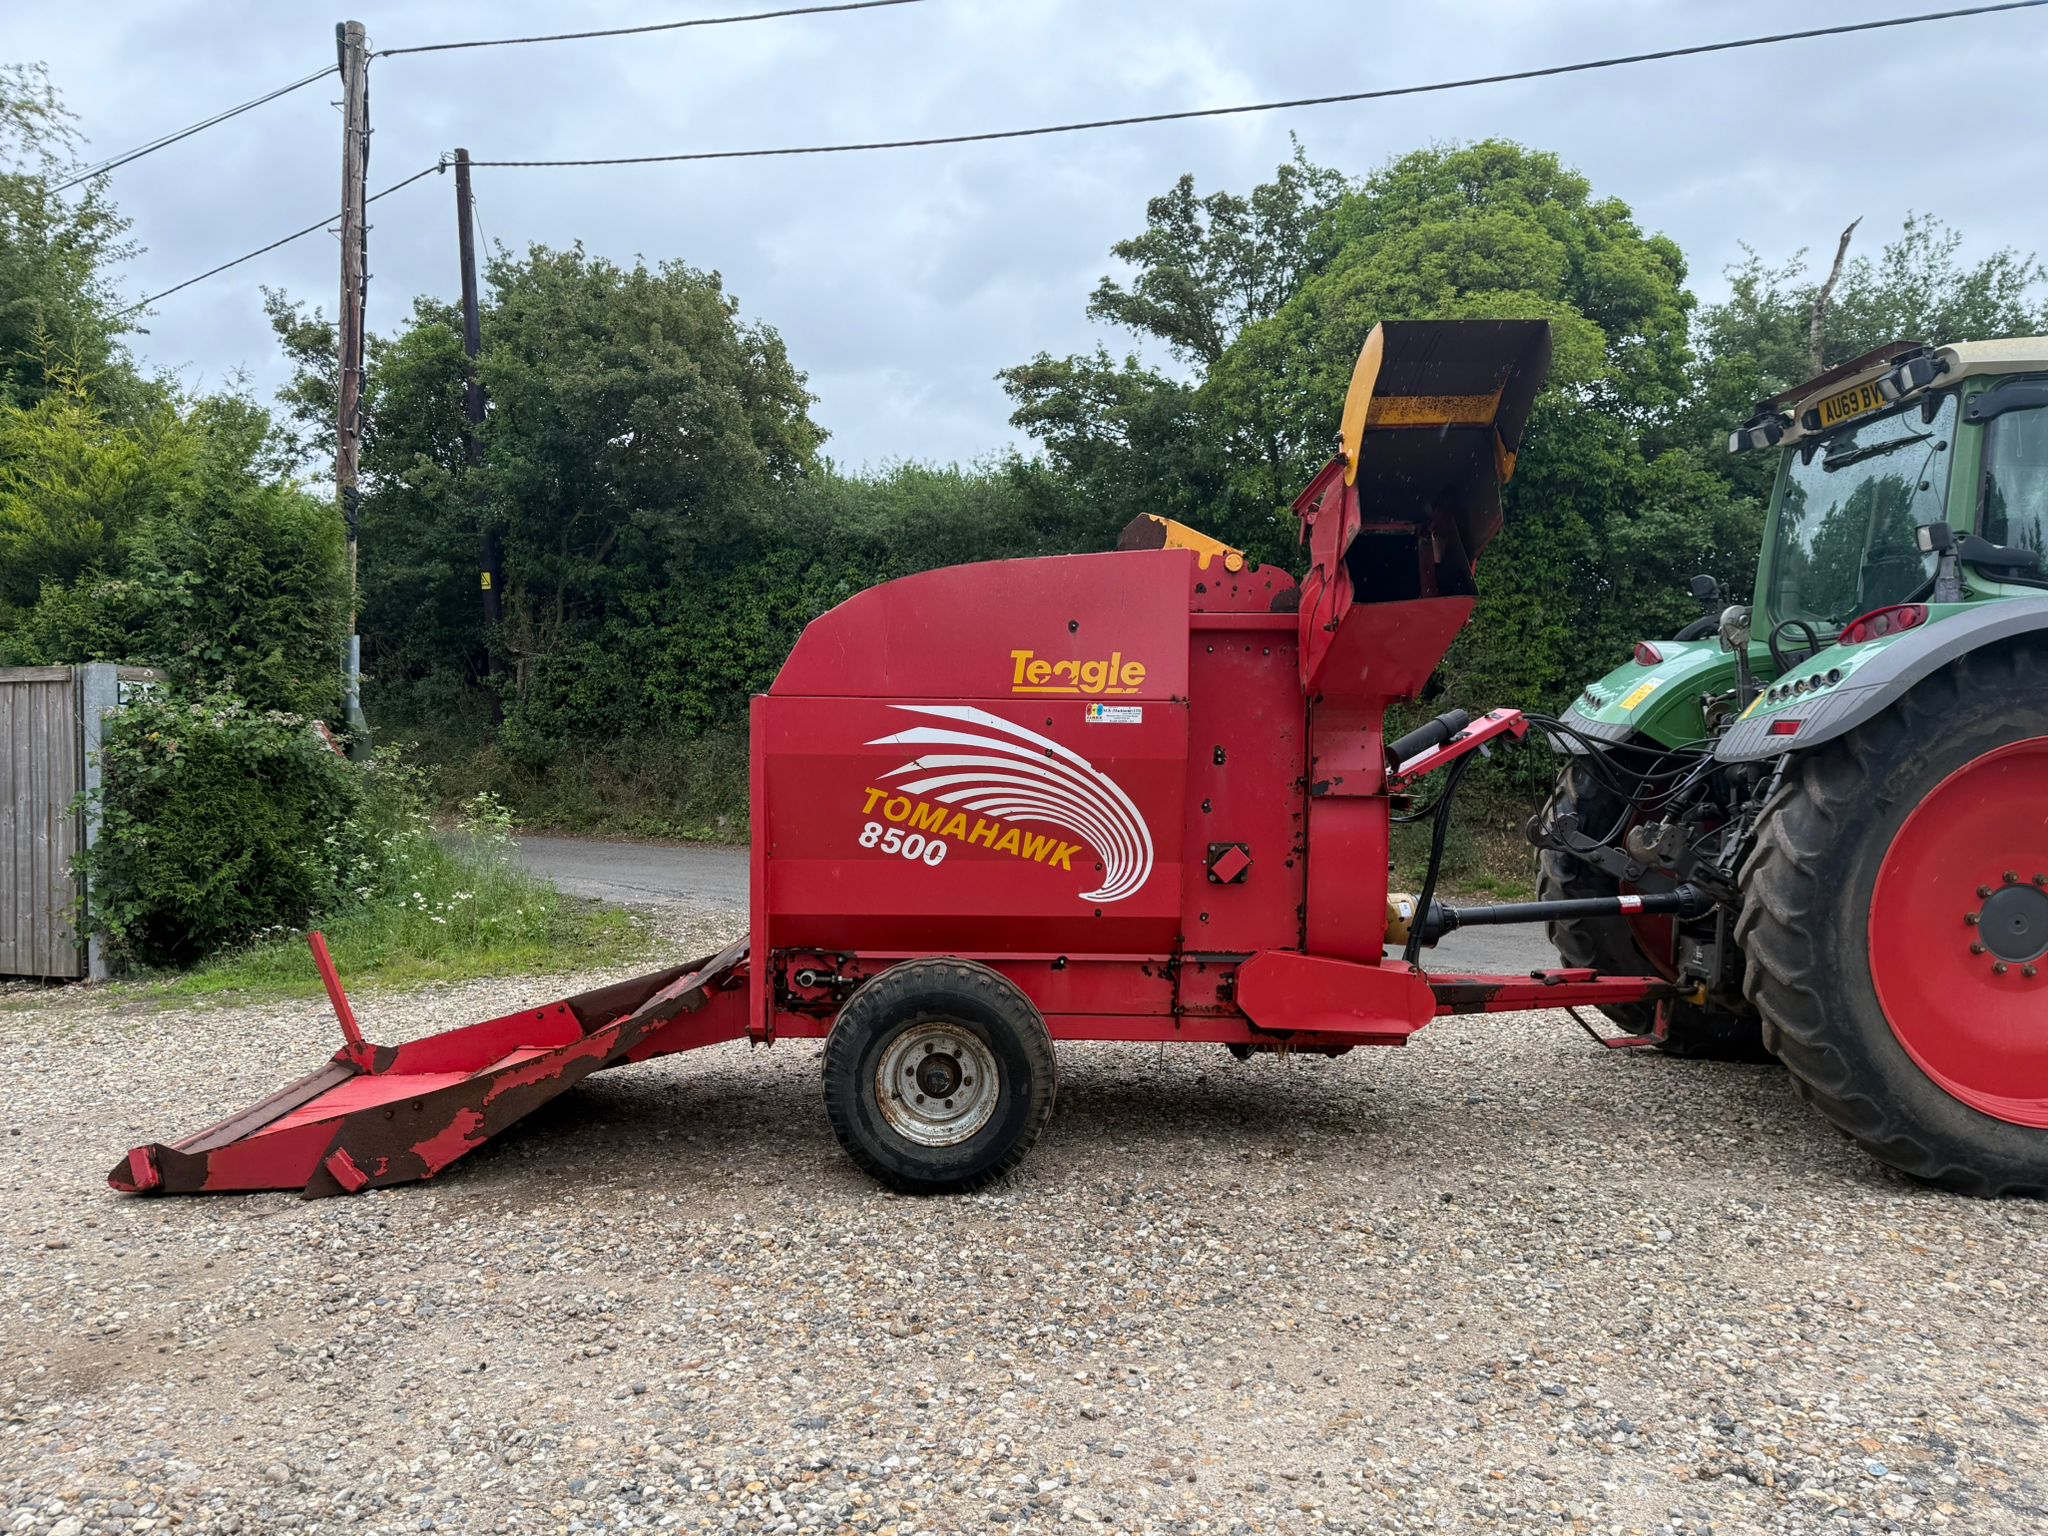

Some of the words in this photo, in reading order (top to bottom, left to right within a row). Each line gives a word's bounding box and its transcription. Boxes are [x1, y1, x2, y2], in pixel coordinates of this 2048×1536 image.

[1826, 391, 1859, 422] AU69
[1010, 650, 1147, 693] Teagle
[858, 821, 948, 866] 8500
[862, 787, 1083, 871] TOMAHAWK
